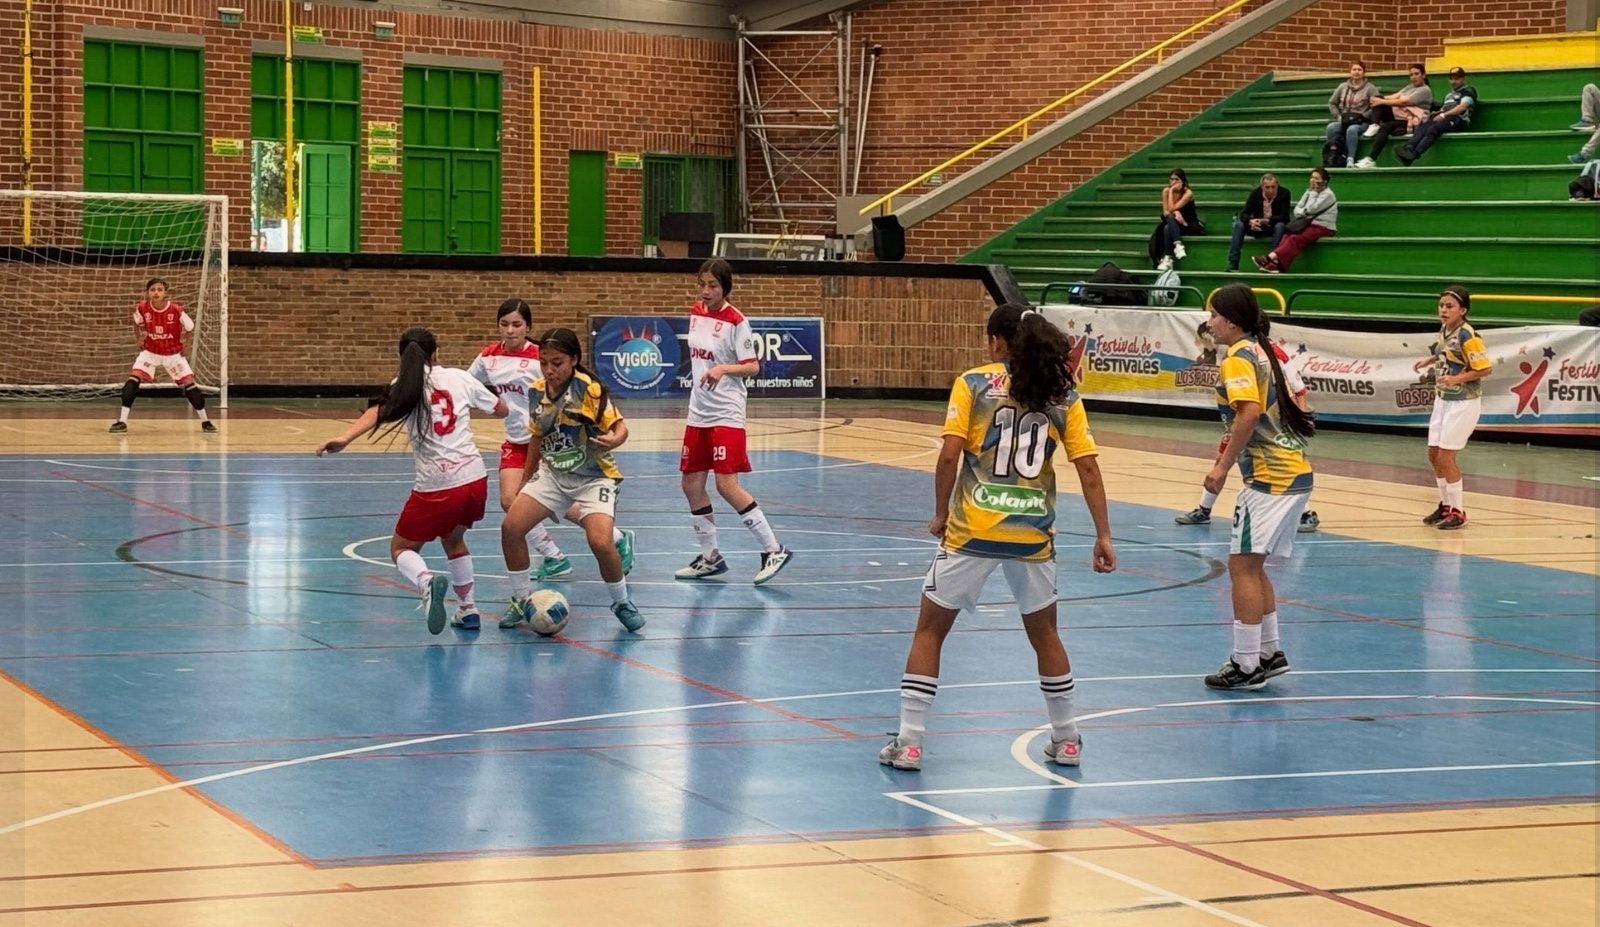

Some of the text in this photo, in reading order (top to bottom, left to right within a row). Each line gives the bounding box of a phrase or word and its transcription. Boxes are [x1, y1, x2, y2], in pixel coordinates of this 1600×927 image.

[155, 325, 164, 334] 10
[1096, 334, 1152, 355] Festival de
[615, 351, 661, 367] VIGOR
[690, 348, 715, 362] UNZA
[1301, 355, 1371, 375] Festival de
[745, 377, 755, 388] de
[756, 378, 791, 388] nuestros
[1177, 370, 1196, 385] LOS
[496, 383, 525, 396] UNZA
[1396, 389, 1418, 407] LOS
[430, 389, 458, 437] 3
[992, 404, 1051, 481] 10
[713, 445, 727, 461] 29
[598, 487, 609, 503] 6
